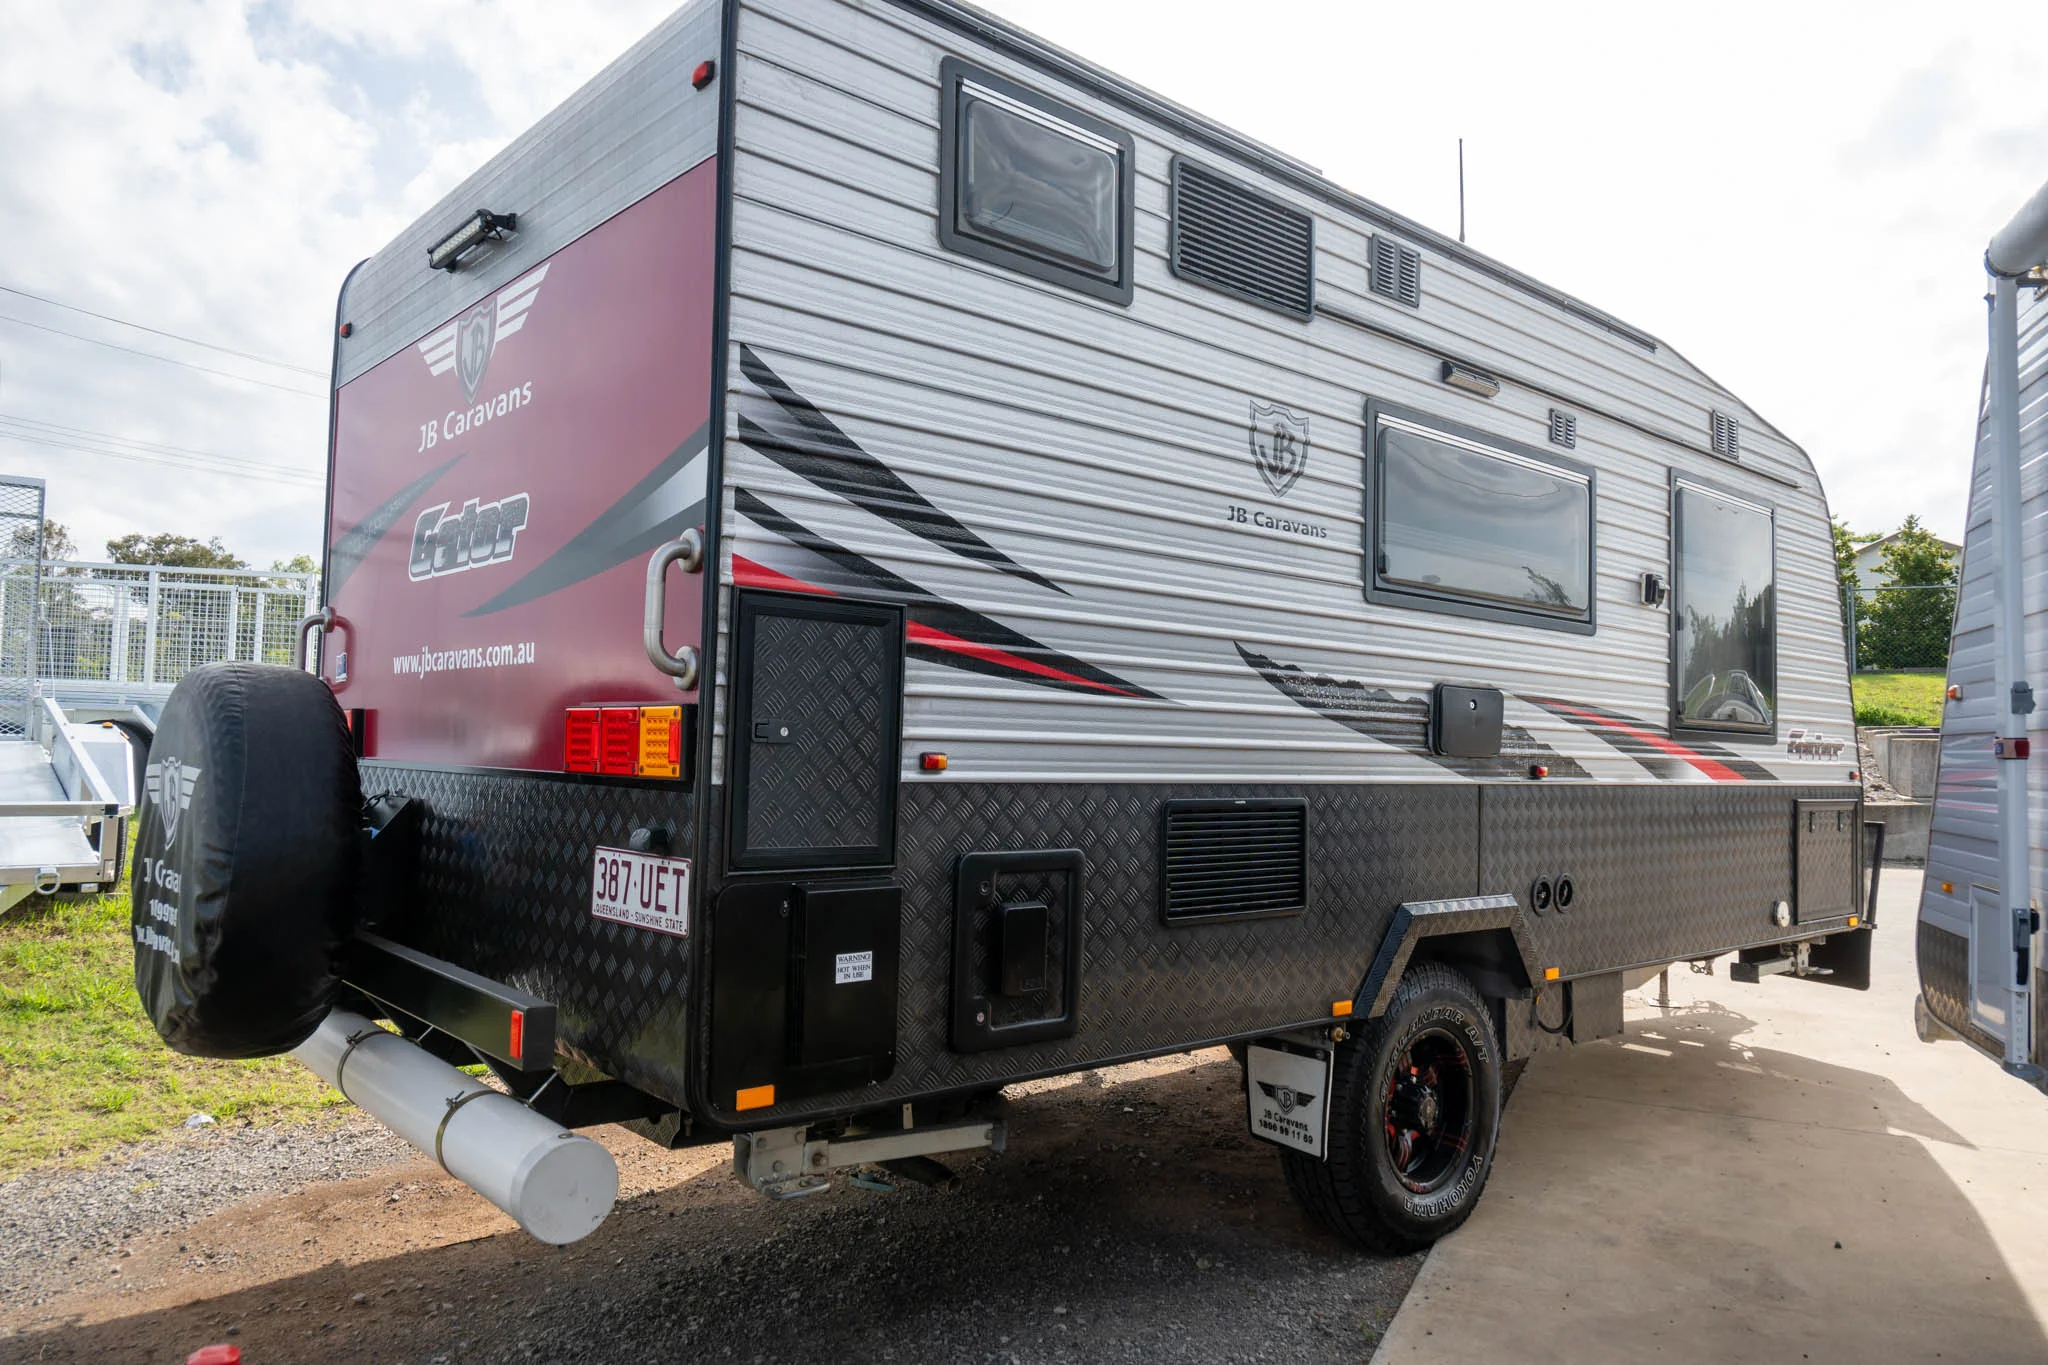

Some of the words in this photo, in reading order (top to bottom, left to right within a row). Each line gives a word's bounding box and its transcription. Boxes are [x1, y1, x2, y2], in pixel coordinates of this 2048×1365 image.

[418, 420, 438, 453] JB
[443, 381, 532, 440] Caravans
[408, 491, 530, 582] Gator
[1227, 505, 1248, 524] JB
[1253, 511, 1328, 539] Caravans
[393, 642, 535, 680] www.jbcaravans.com.au
[596, 903, 630, 920] QUEENSLAND
[635, 911, 662, 928] SUNSHINE
[665, 918, 683, 932] STATE
[852, 964, 871, 972] WHEN
[1465, 1025, 1489, 1064] A/T
[1264, 1108, 1273, 1120] JB
[1274, 1112, 1308, 1132] Caravans
[1292, 1130, 1300, 1141] 11
[1404, 1154, 1483, 1217] YOKOHAMA
